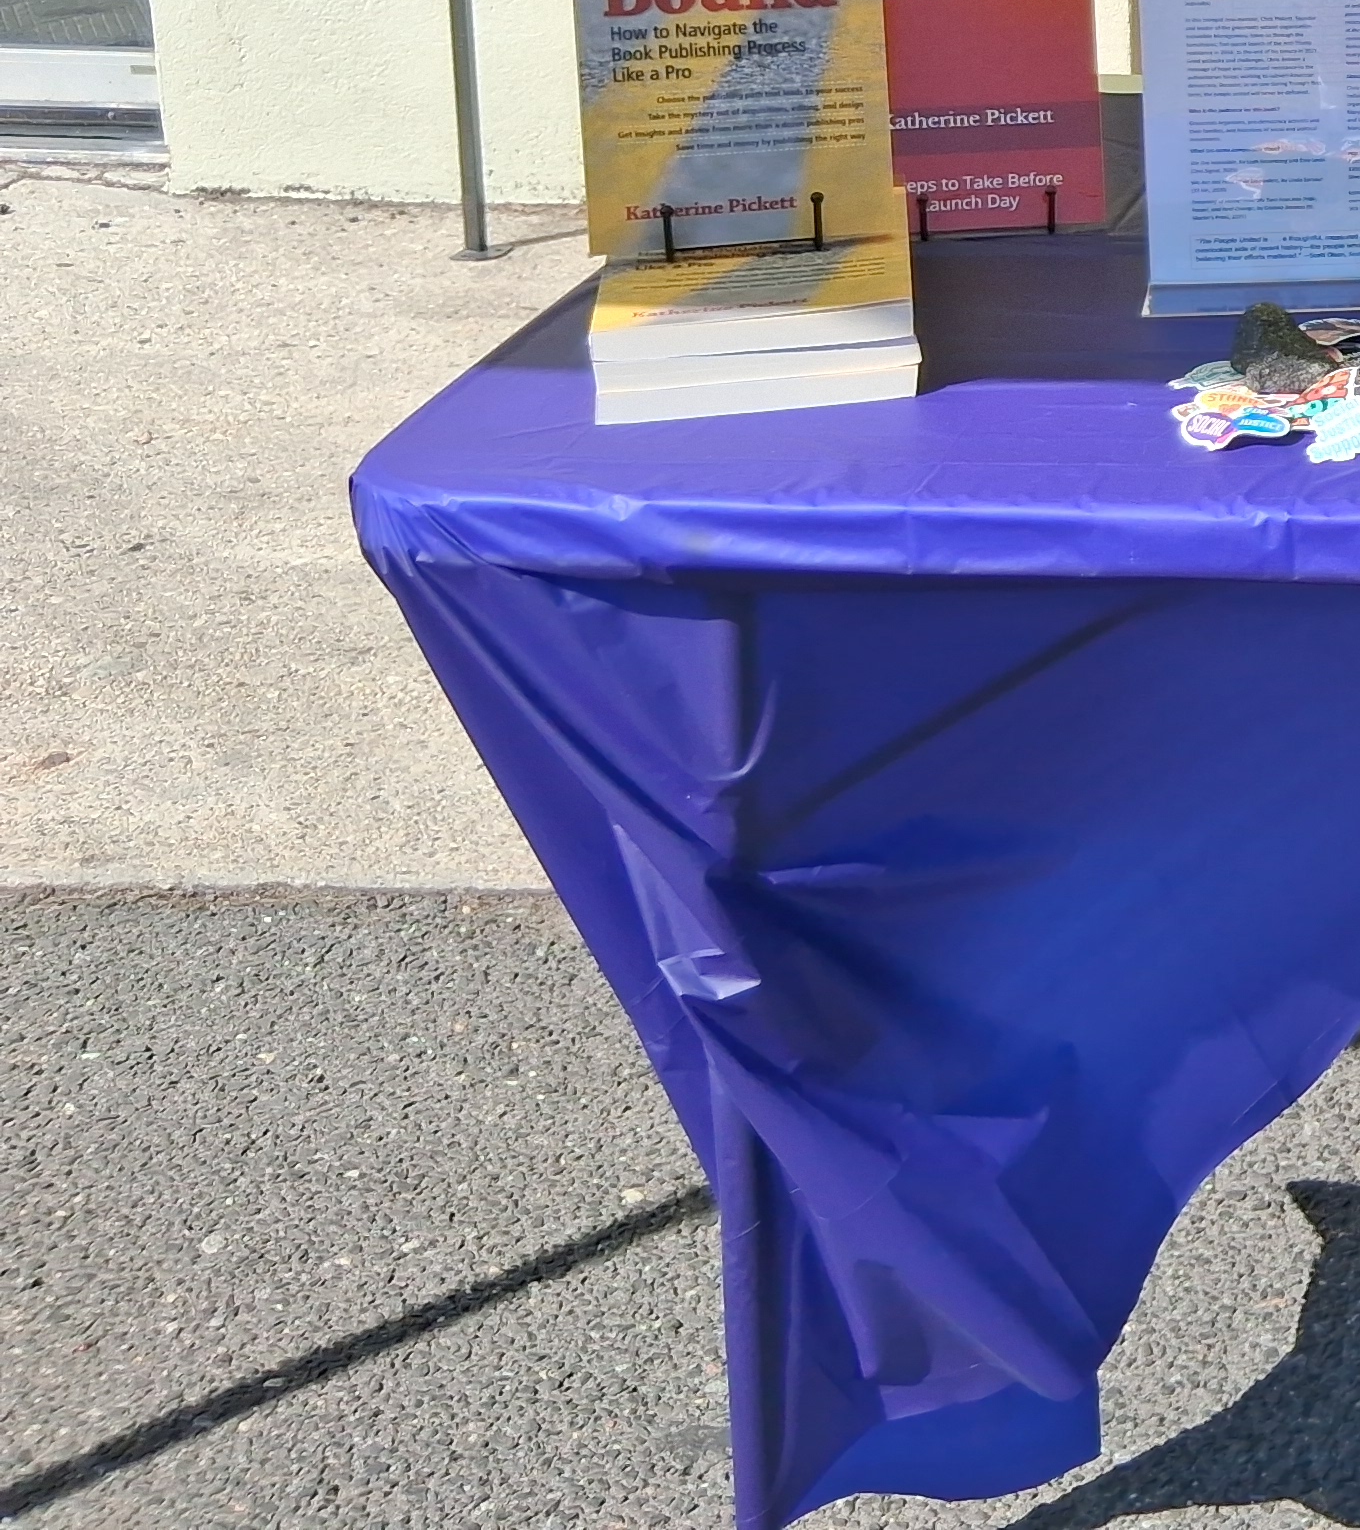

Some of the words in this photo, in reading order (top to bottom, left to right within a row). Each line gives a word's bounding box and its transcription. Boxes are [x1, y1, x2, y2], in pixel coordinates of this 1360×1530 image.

[610, 25, 648, 41] How
[653, 26, 670, 39] to
[675, 21, 748, 39] Navigate
[752, 19, 778, 34] the
[612, 46, 653, 63] Book
[658, 41, 742, 60] Publishing
[747, 39, 806, 54] Process
[612, 66, 645, 83] Like
[650, 69, 660, 80] a
[665, 65, 692, 80] Pro
[986, 107, 1055, 126] Pickett
[904, 179, 937, 194] eps
[941, 178, 959, 191] to
[962, 174, 1003, 190] Take
[1008, 172, 1064, 189] Before
[727, 195, 797, 214] Pickett
[987, 193, 1020, 211] Day
[1188, 414, 1232, 436] SOCIAL
[1238, 417, 1283, 432] JUSTICE
